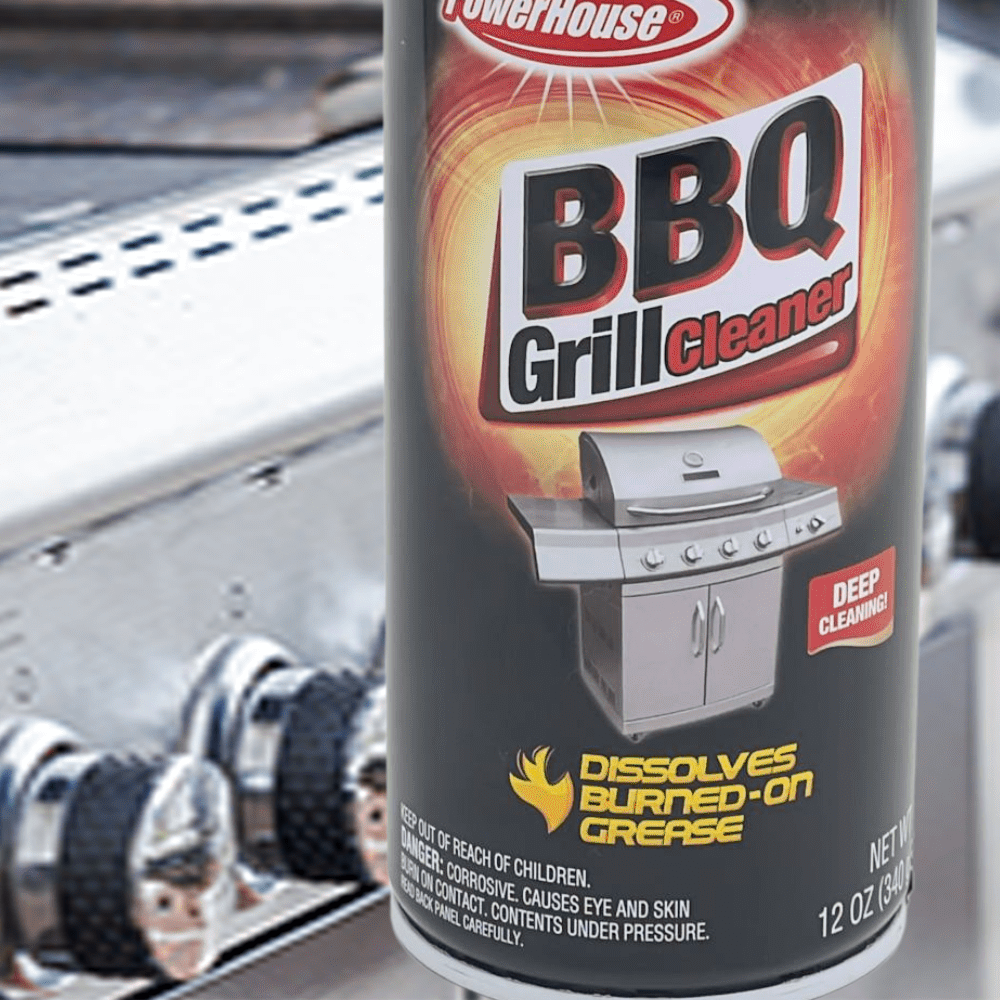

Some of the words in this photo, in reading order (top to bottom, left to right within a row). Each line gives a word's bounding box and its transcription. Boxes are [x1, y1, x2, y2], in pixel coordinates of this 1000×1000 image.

[522, 94, 846, 320] BBQ
[508, 305, 663, 405] Grill
[664, 262, 853, 377] Cleaner
[818, 591, 888, 636] CLEANING!
[832, 566, 881, 609] DEEP
[580, 742, 799, 785] DISSOLVES
[401, 802, 417, 829] KEEP
[419, 818, 436, 843] OUT
[438, 830, 451, 851] OF
[453, 837, 491, 869] REACH
[494, 852, 511, 873] OF
[514, 857, 591, 888] CHILDREN.
[580, 814, 745, 847] GREASE
[869, 825, 898, 873] NET
[401, 825, 444, 876] DANGER:
[447, 861, 519, 903] CORROSIVE.
[523, 887, 579, 915] CAUSES
[584, 897, 612, 917] EYE
[616, 900, 649, 919] AND
[653, 899, 690, 919] SKIN
[401, 851, 420, 883] BURN
[421, 869, 433, 893] ON
[435, 879, 488, 918] CONTACT.
[491, 902, 562, 935] CONTENTS
[567, 918, 619, 941] UNDER
[623, 920, 710, 943] PRESSURE.
[401, 874, 415, 899] READ
[416, 887, 433, 913] BACK
[434, 901, 461, 928] PANEL
[463, 914, 524, 947] CAREFULLY.
[819, 902, 844, 937] 12
[850, 885, 874, 925] OZ
